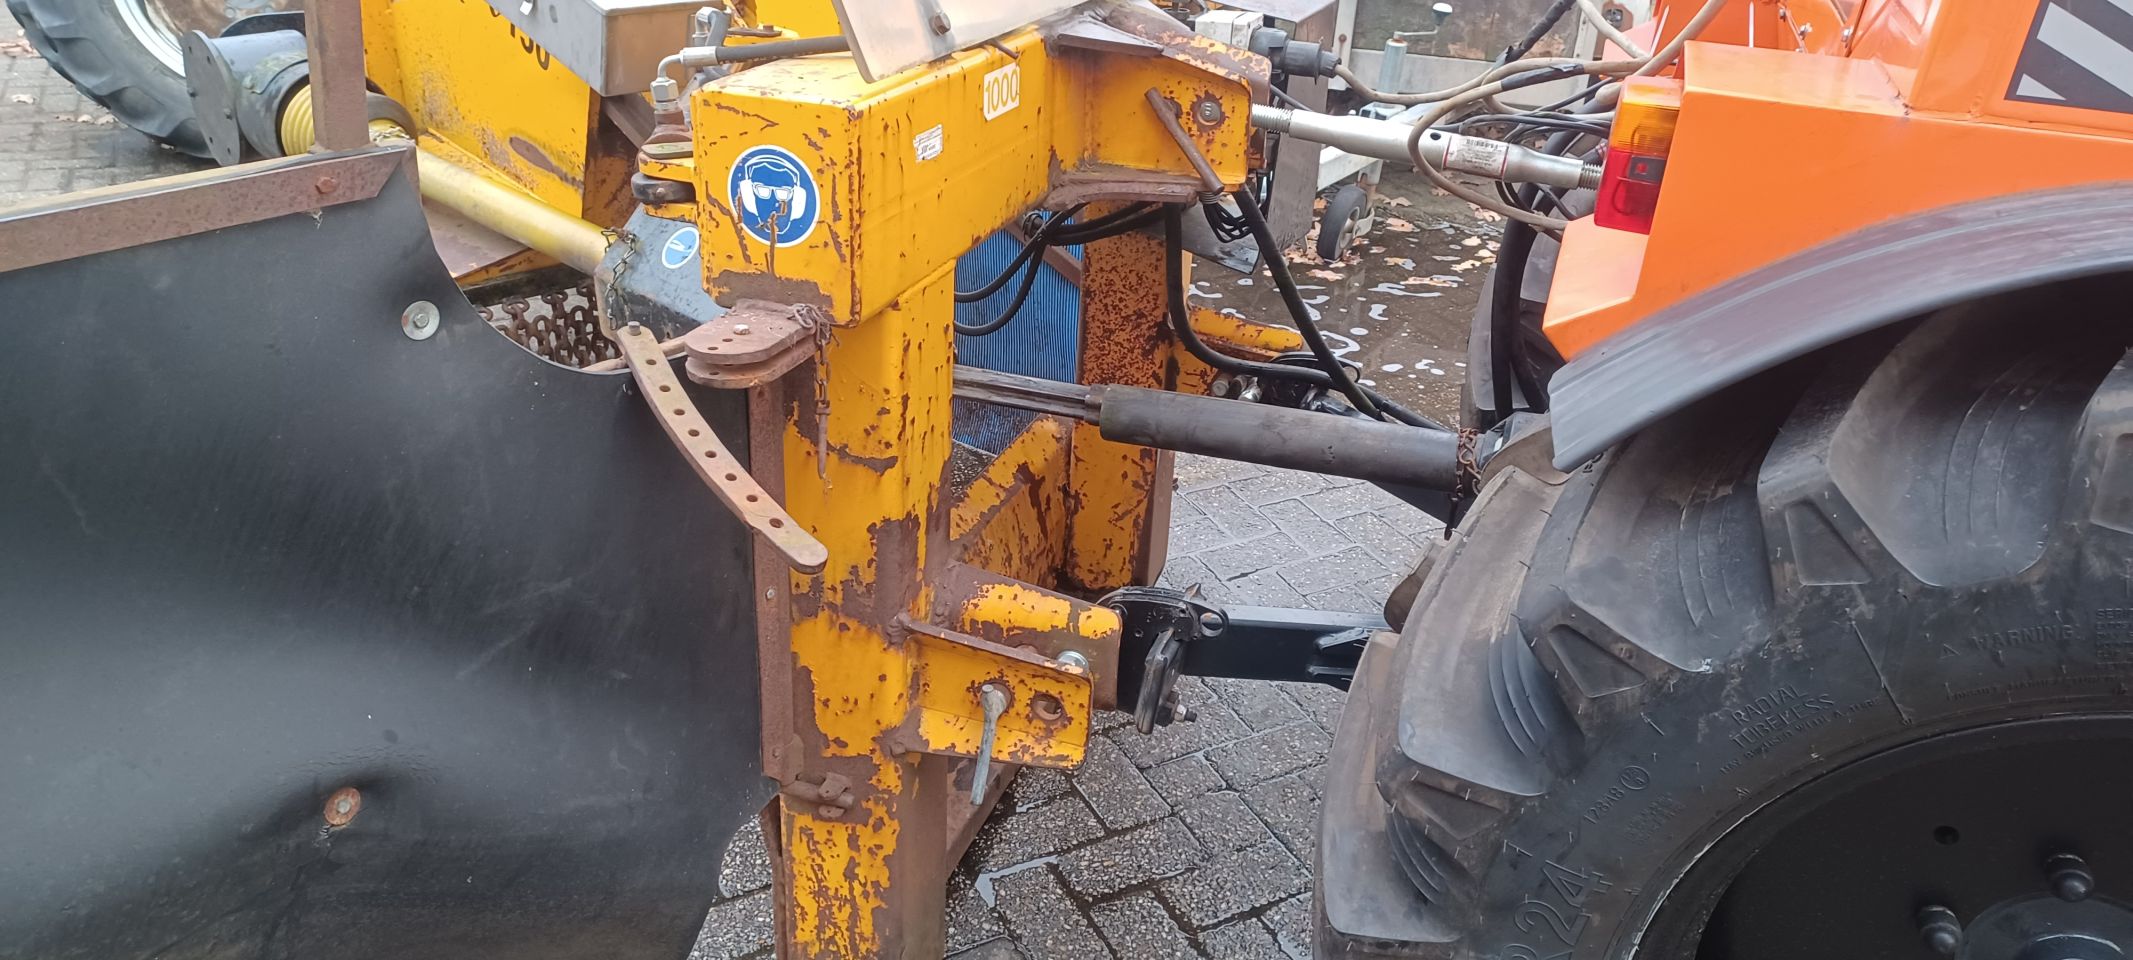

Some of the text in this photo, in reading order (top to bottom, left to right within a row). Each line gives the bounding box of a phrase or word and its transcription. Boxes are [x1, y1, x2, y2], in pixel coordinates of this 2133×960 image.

[985, 69, 1019, 114] 1000
[1732, 684, 1808, 726] RADIAL
[1732, 693, 1835, 748] TUBELESS
